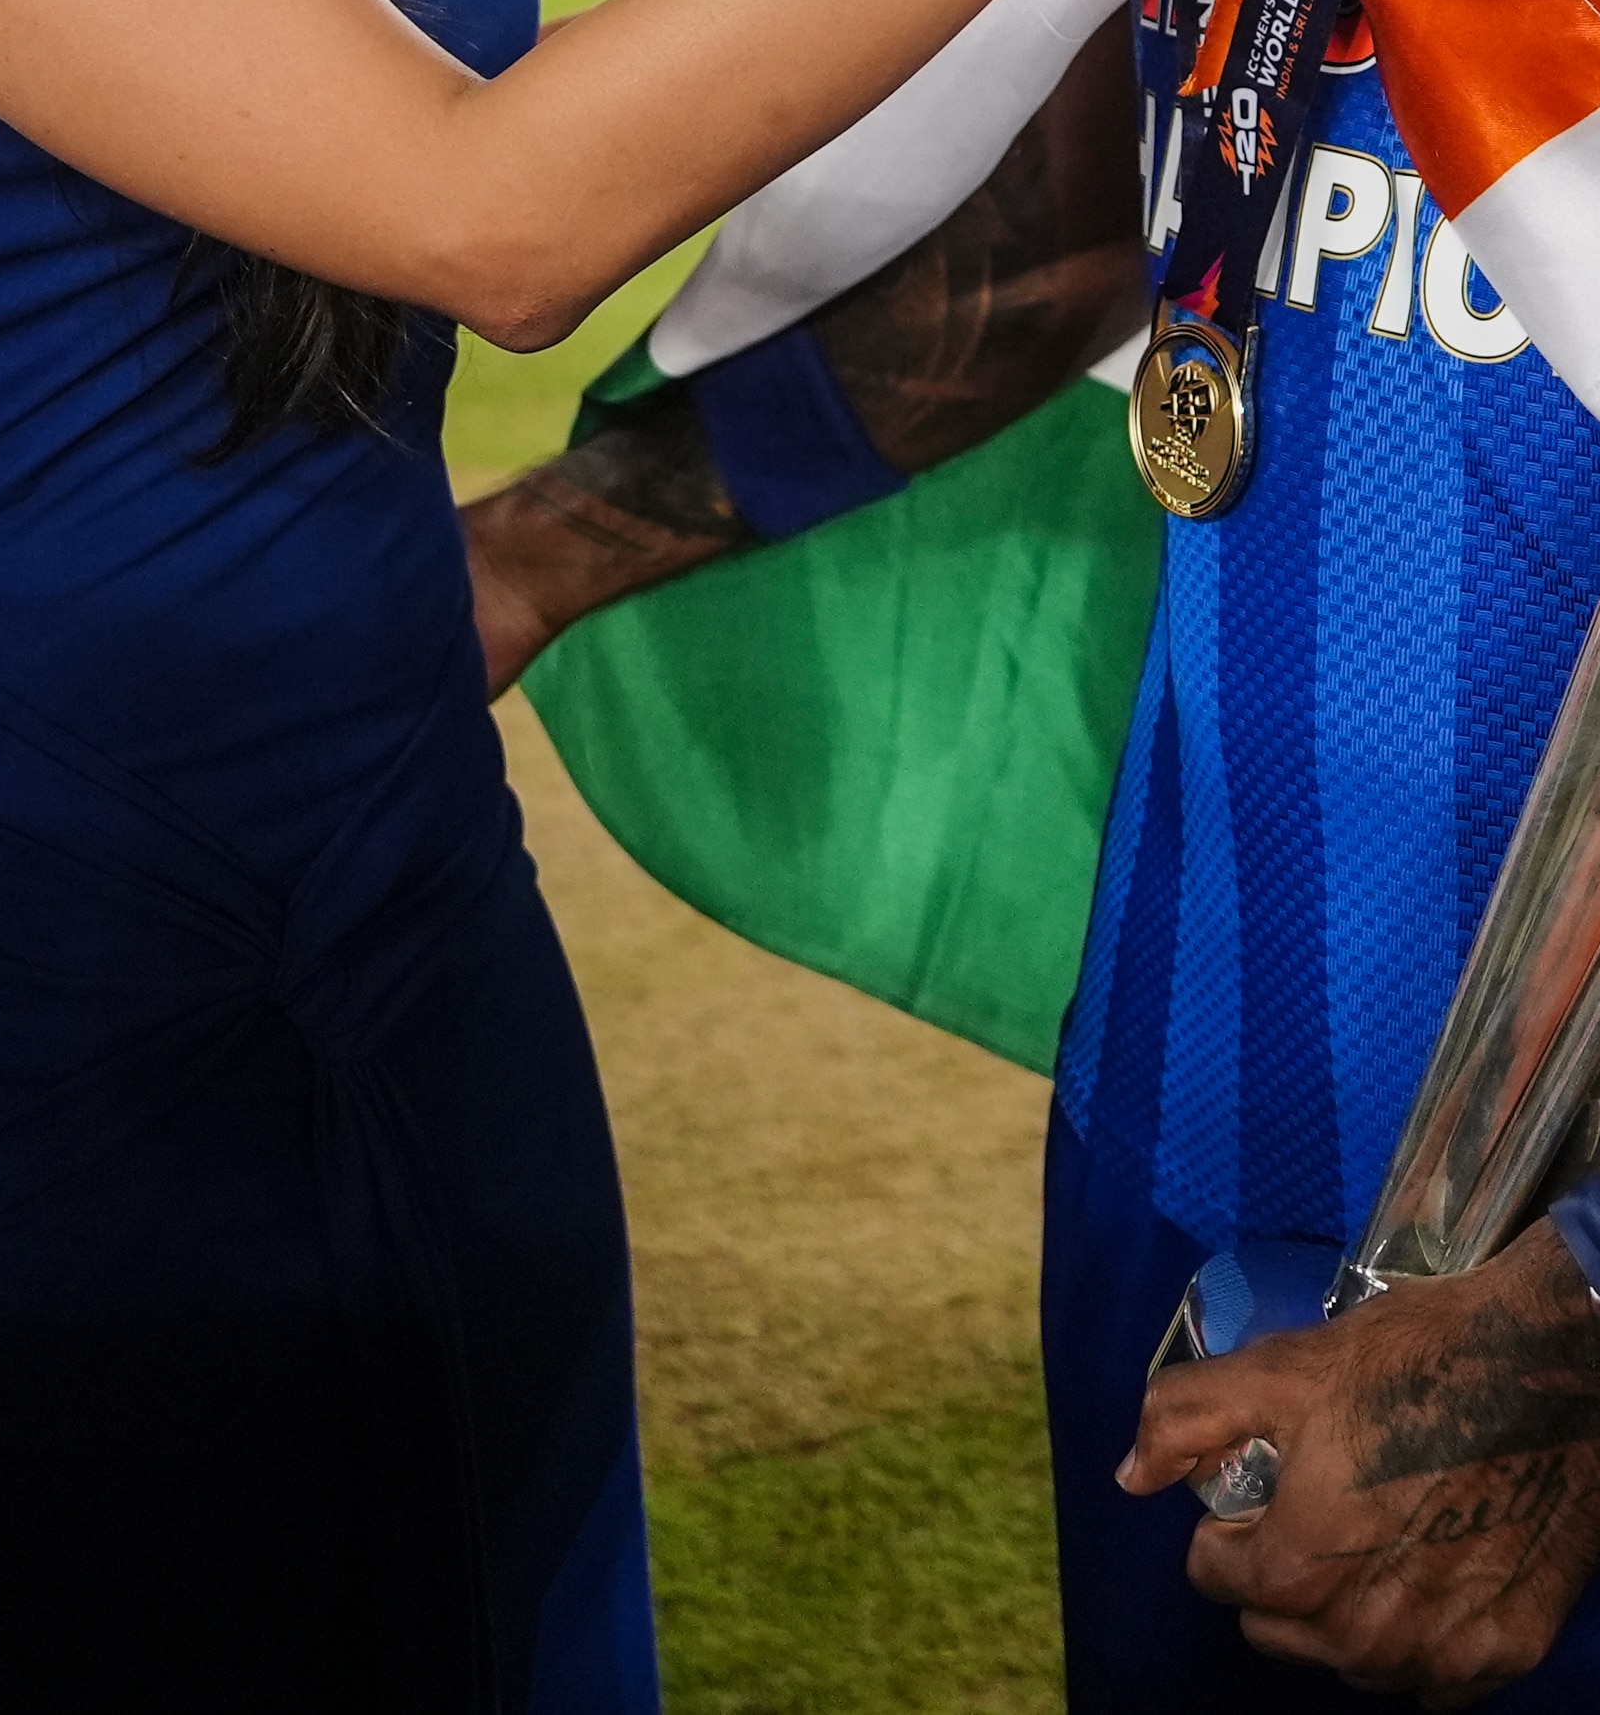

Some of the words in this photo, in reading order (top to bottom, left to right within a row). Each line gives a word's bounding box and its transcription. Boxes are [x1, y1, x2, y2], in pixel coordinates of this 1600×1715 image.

[1293, 12, 1309, 40] SRI
[1288, 41, 1299, 54] &
[1245, 48, 1261, 79] ICC
[1275, 56, 1296, 100] INDIA
[1231, 87, 1259, 196] T20
